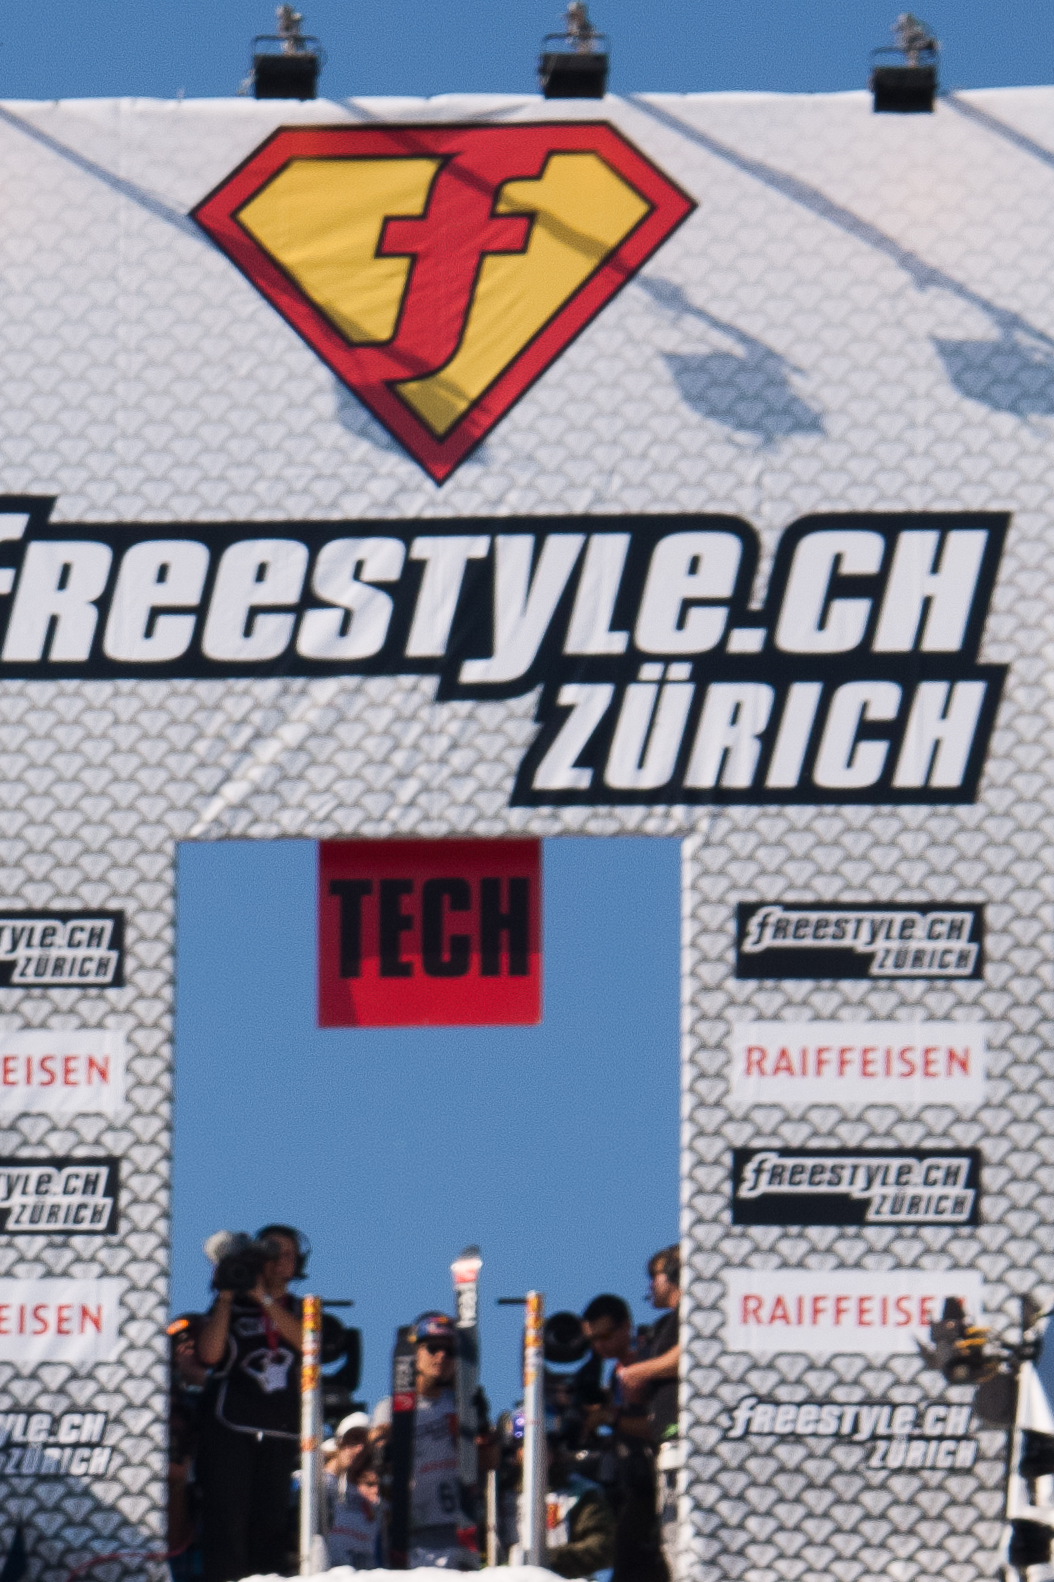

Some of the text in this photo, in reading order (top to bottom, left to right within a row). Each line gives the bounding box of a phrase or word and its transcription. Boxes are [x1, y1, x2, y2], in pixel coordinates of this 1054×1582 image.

[531, 664, 986, 790] ZÜRICH
[330, 877, 529, 978] TECH
[745, 1046, 970, 1077] RAIFFEISEN
[741, 1294, 966, 1328] RAIFFEISE
